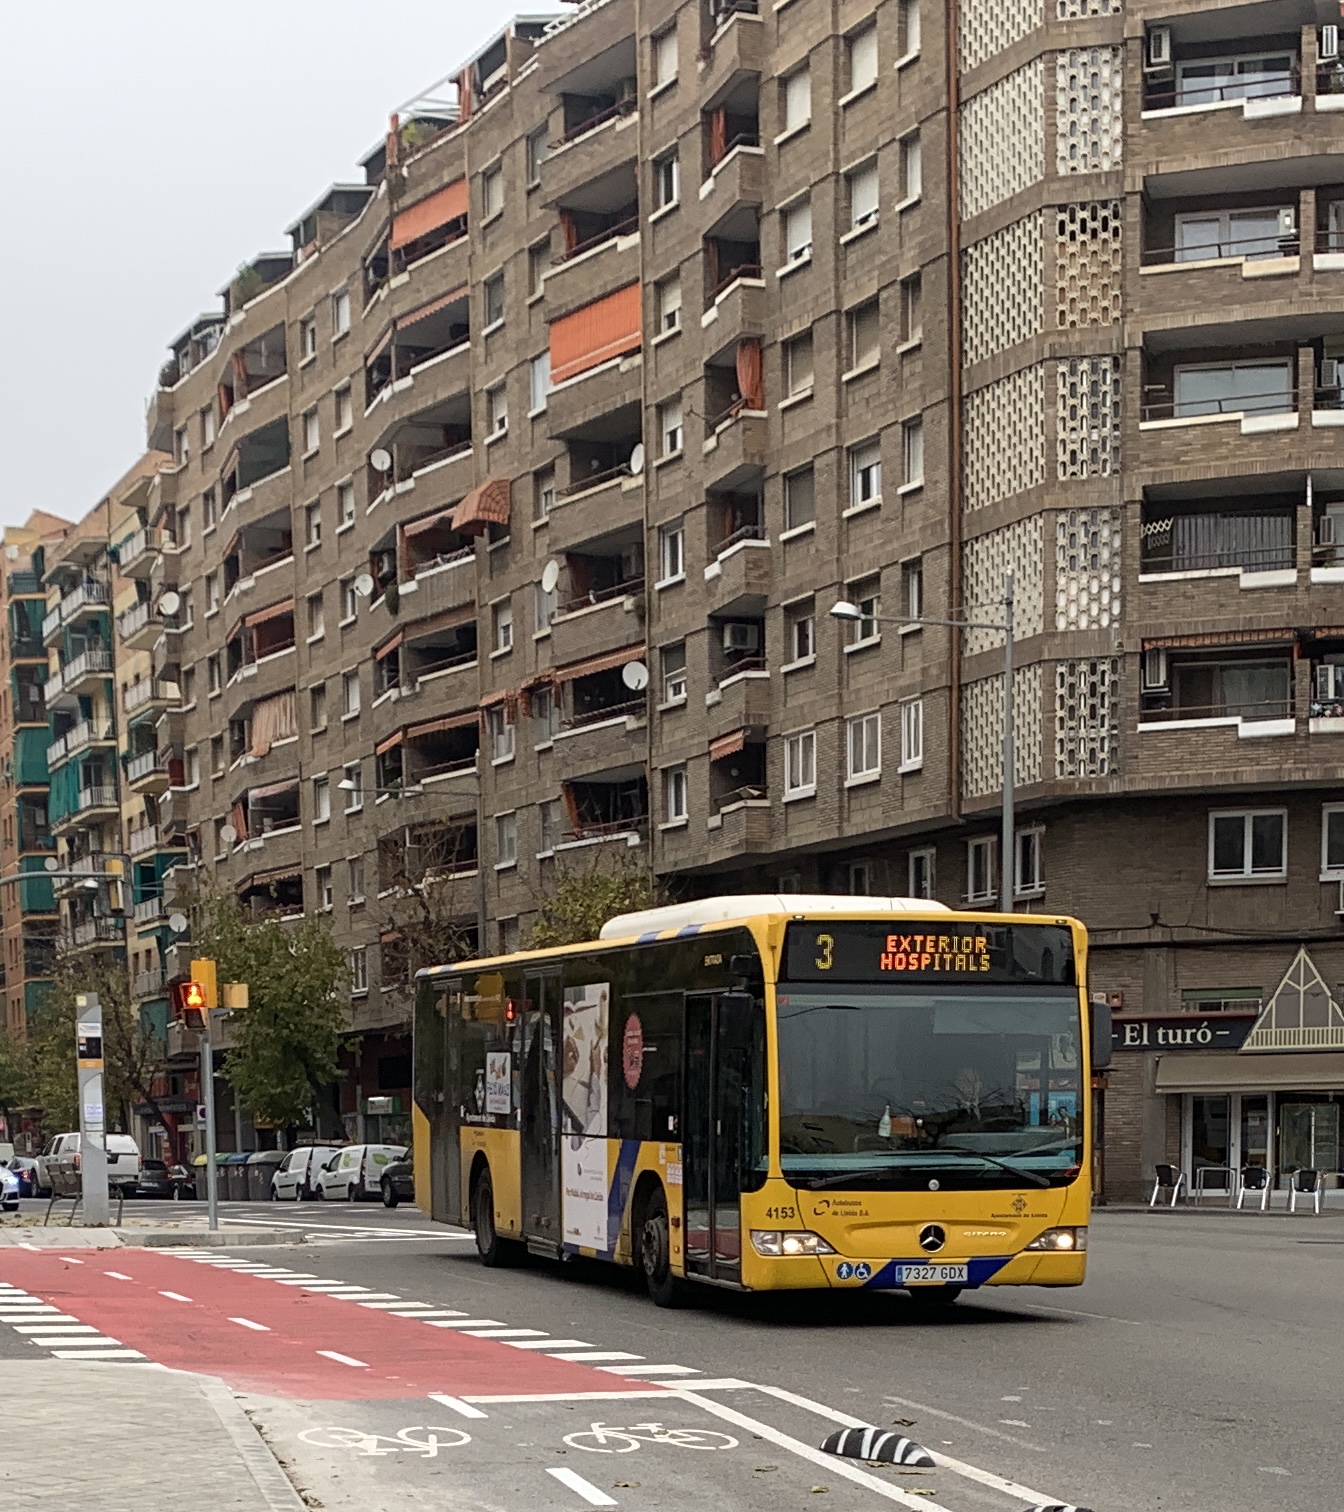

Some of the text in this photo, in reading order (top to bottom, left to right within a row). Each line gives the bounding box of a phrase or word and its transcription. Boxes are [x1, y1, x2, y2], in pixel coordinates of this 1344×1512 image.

[815, 934, 834, 970] 3
[886, 935, 987, 953] EXTERIOR
[880, 953, 991, 971] HOSPITALS
[1123, 1021, 1213, 1046] El turó
[765, 1206, 796, 1220] 4153
[905, 1267, 964, 1280] 7327 GDX
